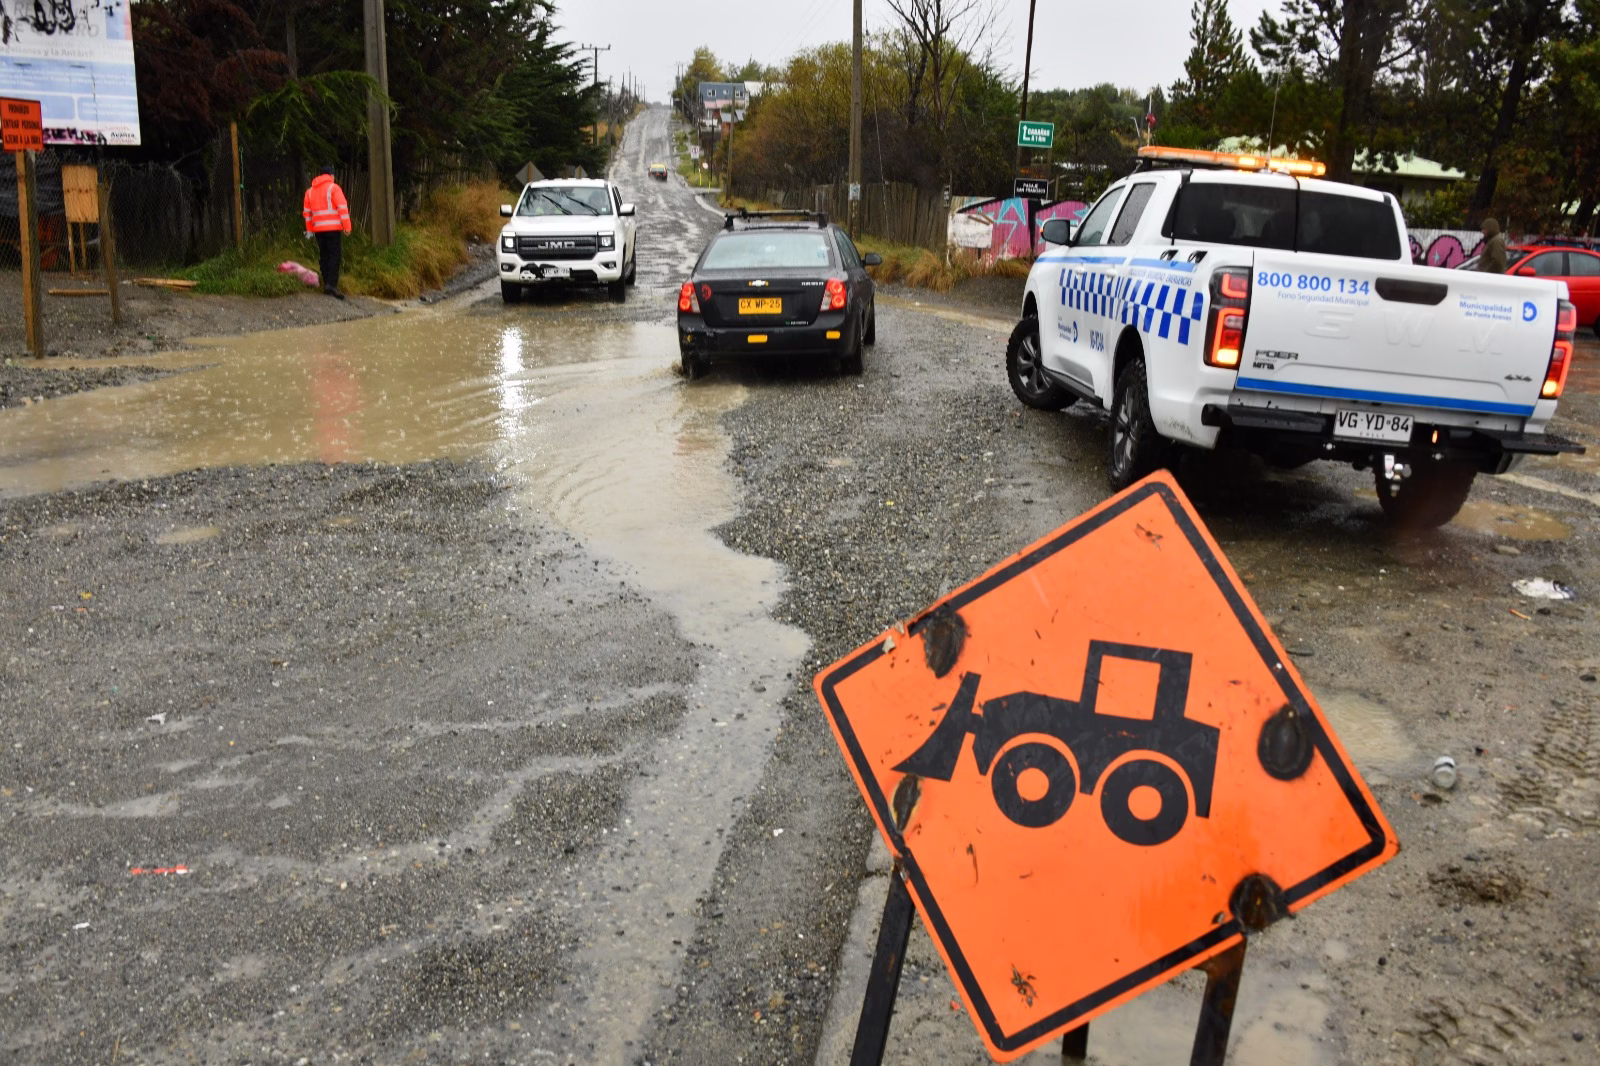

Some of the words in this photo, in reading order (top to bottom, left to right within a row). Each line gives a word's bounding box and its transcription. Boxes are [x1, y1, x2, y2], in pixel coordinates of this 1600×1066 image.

[1257, 271, 1292, 288] 800
[1297, 274, 1332, 292] 800
[1338, 278, 1370, 295] 134
[740, 300, 752, 309] CX
[1277, 290, 1296, 300] Fono
[1297, 292, 1334, 304] Seguridad
[1335, 296, 1370, 307] Municipal
[1459, 301, 1512, 313] Municipalidad
[1473, 311, 1491, 319] Punta
[1491, 313, 1512, 321] Arenas
